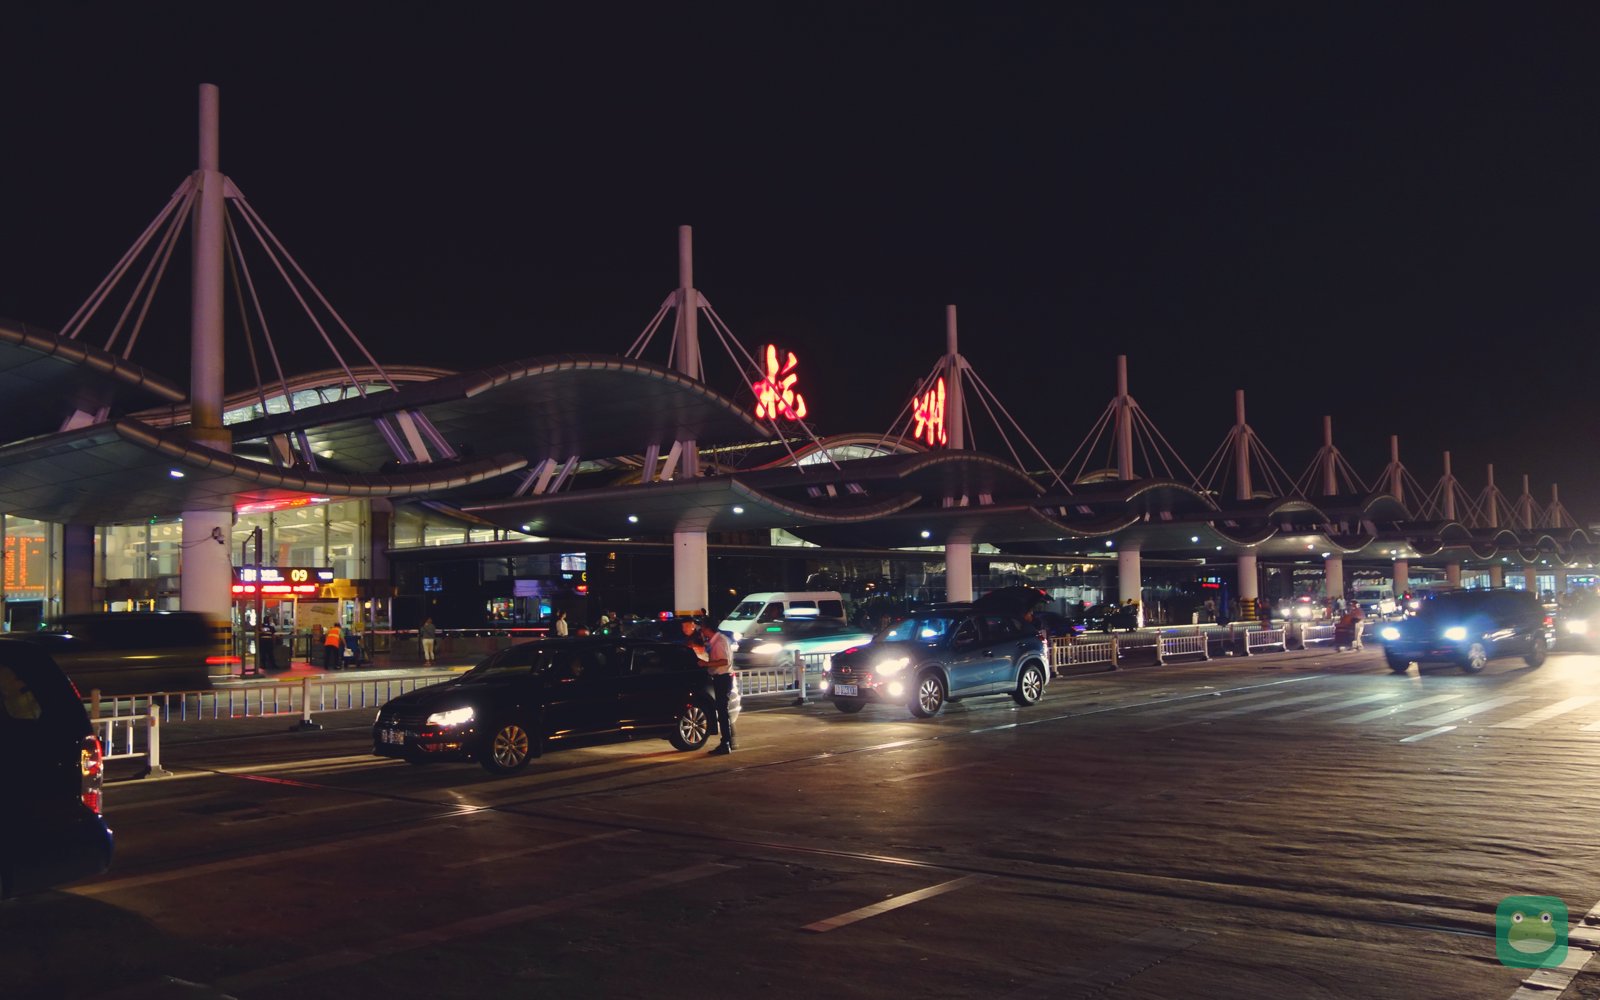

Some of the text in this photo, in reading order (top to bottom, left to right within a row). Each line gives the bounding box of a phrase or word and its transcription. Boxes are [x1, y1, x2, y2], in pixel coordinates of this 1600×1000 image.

[753, 344, 947, 446] 杭 州
[291, 569, 308, 582] 09
